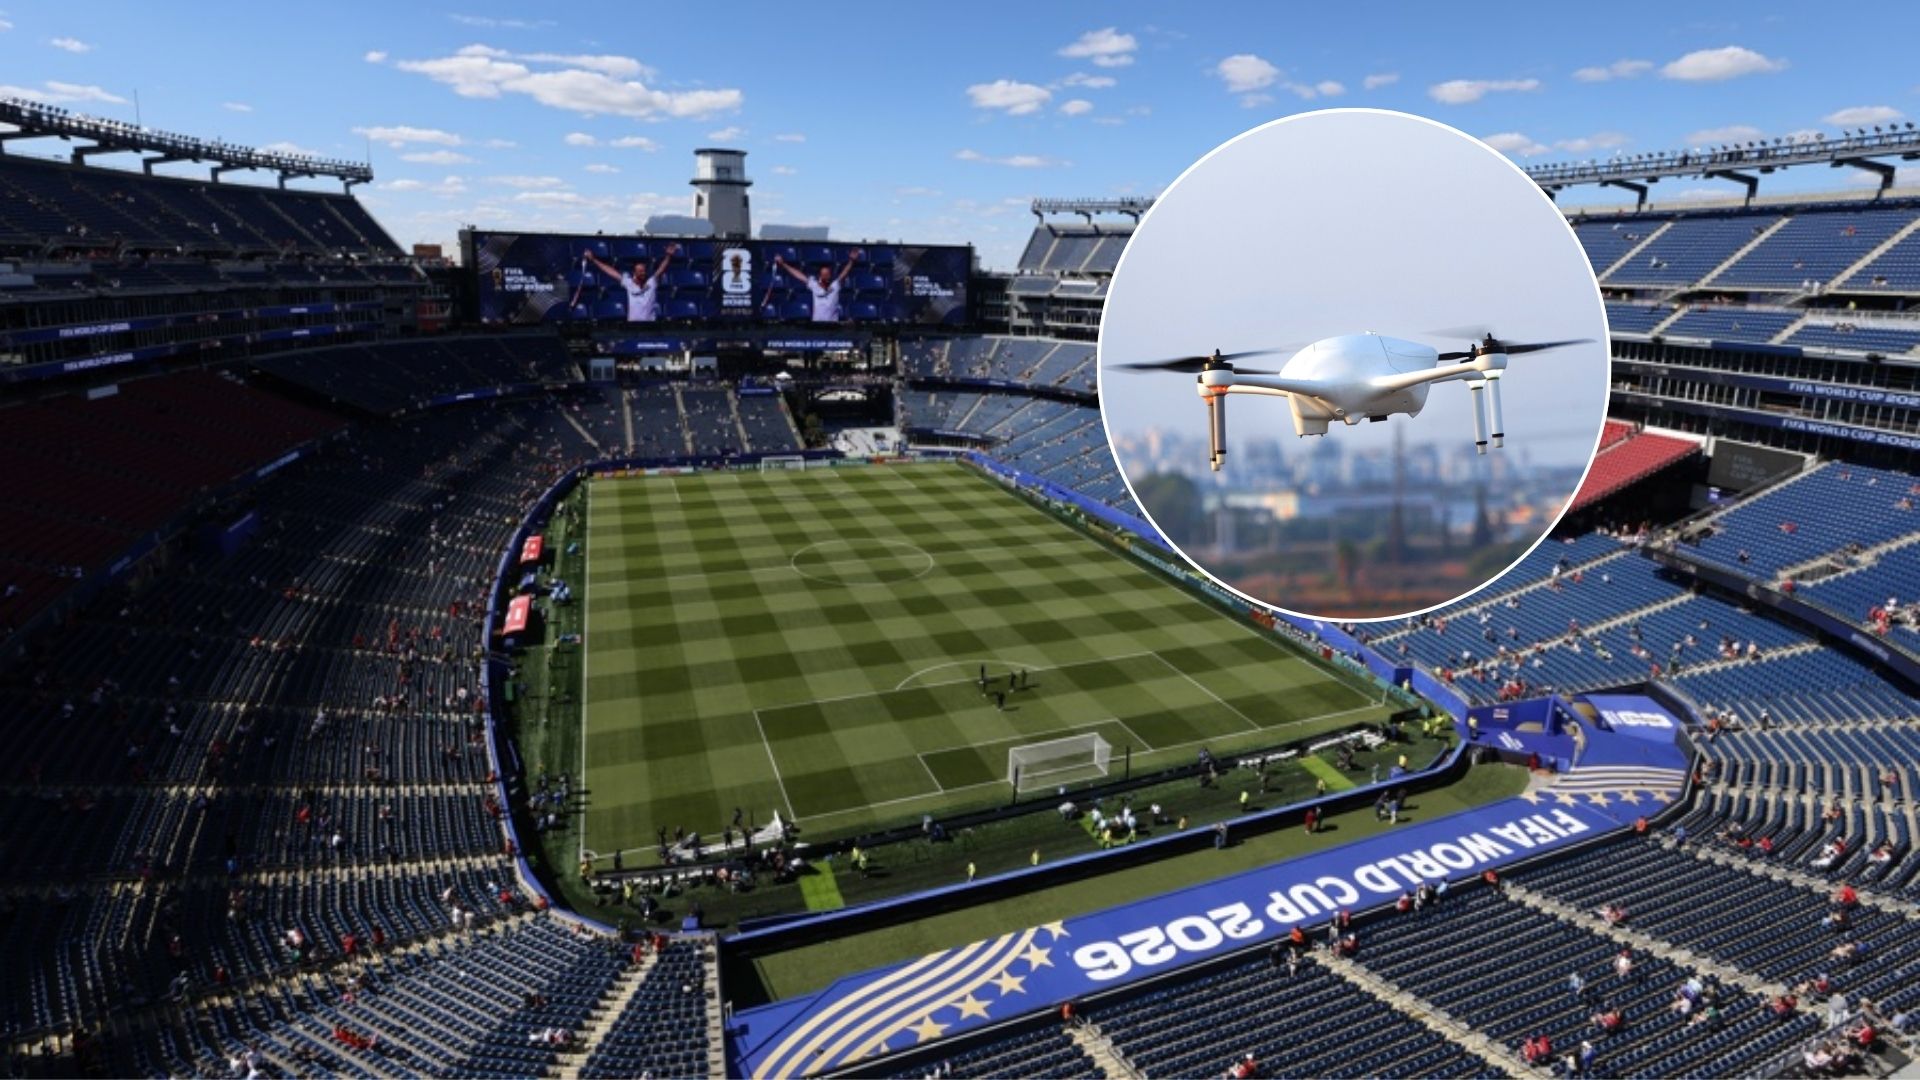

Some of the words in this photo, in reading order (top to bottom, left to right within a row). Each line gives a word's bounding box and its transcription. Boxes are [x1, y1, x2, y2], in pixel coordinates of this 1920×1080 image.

[1788, 382, 1814, 393] FIFA
[1815, 385, 1858, 399] WORLD
[1859, 390, 1885, 401] CUP
[1885, 394, 1920, 406] 202
[1781, 419, 1806, 431] FIFA
[1807, 422, 1850, 437] WORLD
[1850, 428, 1877, 440] CUP
[1489, 808, 1590, 848] FIFA
[1354, 833, 1513, 893] WORLD
[1265, 876, 1360, 923] CUP
[1073, 902, 1265, 980] 2026
